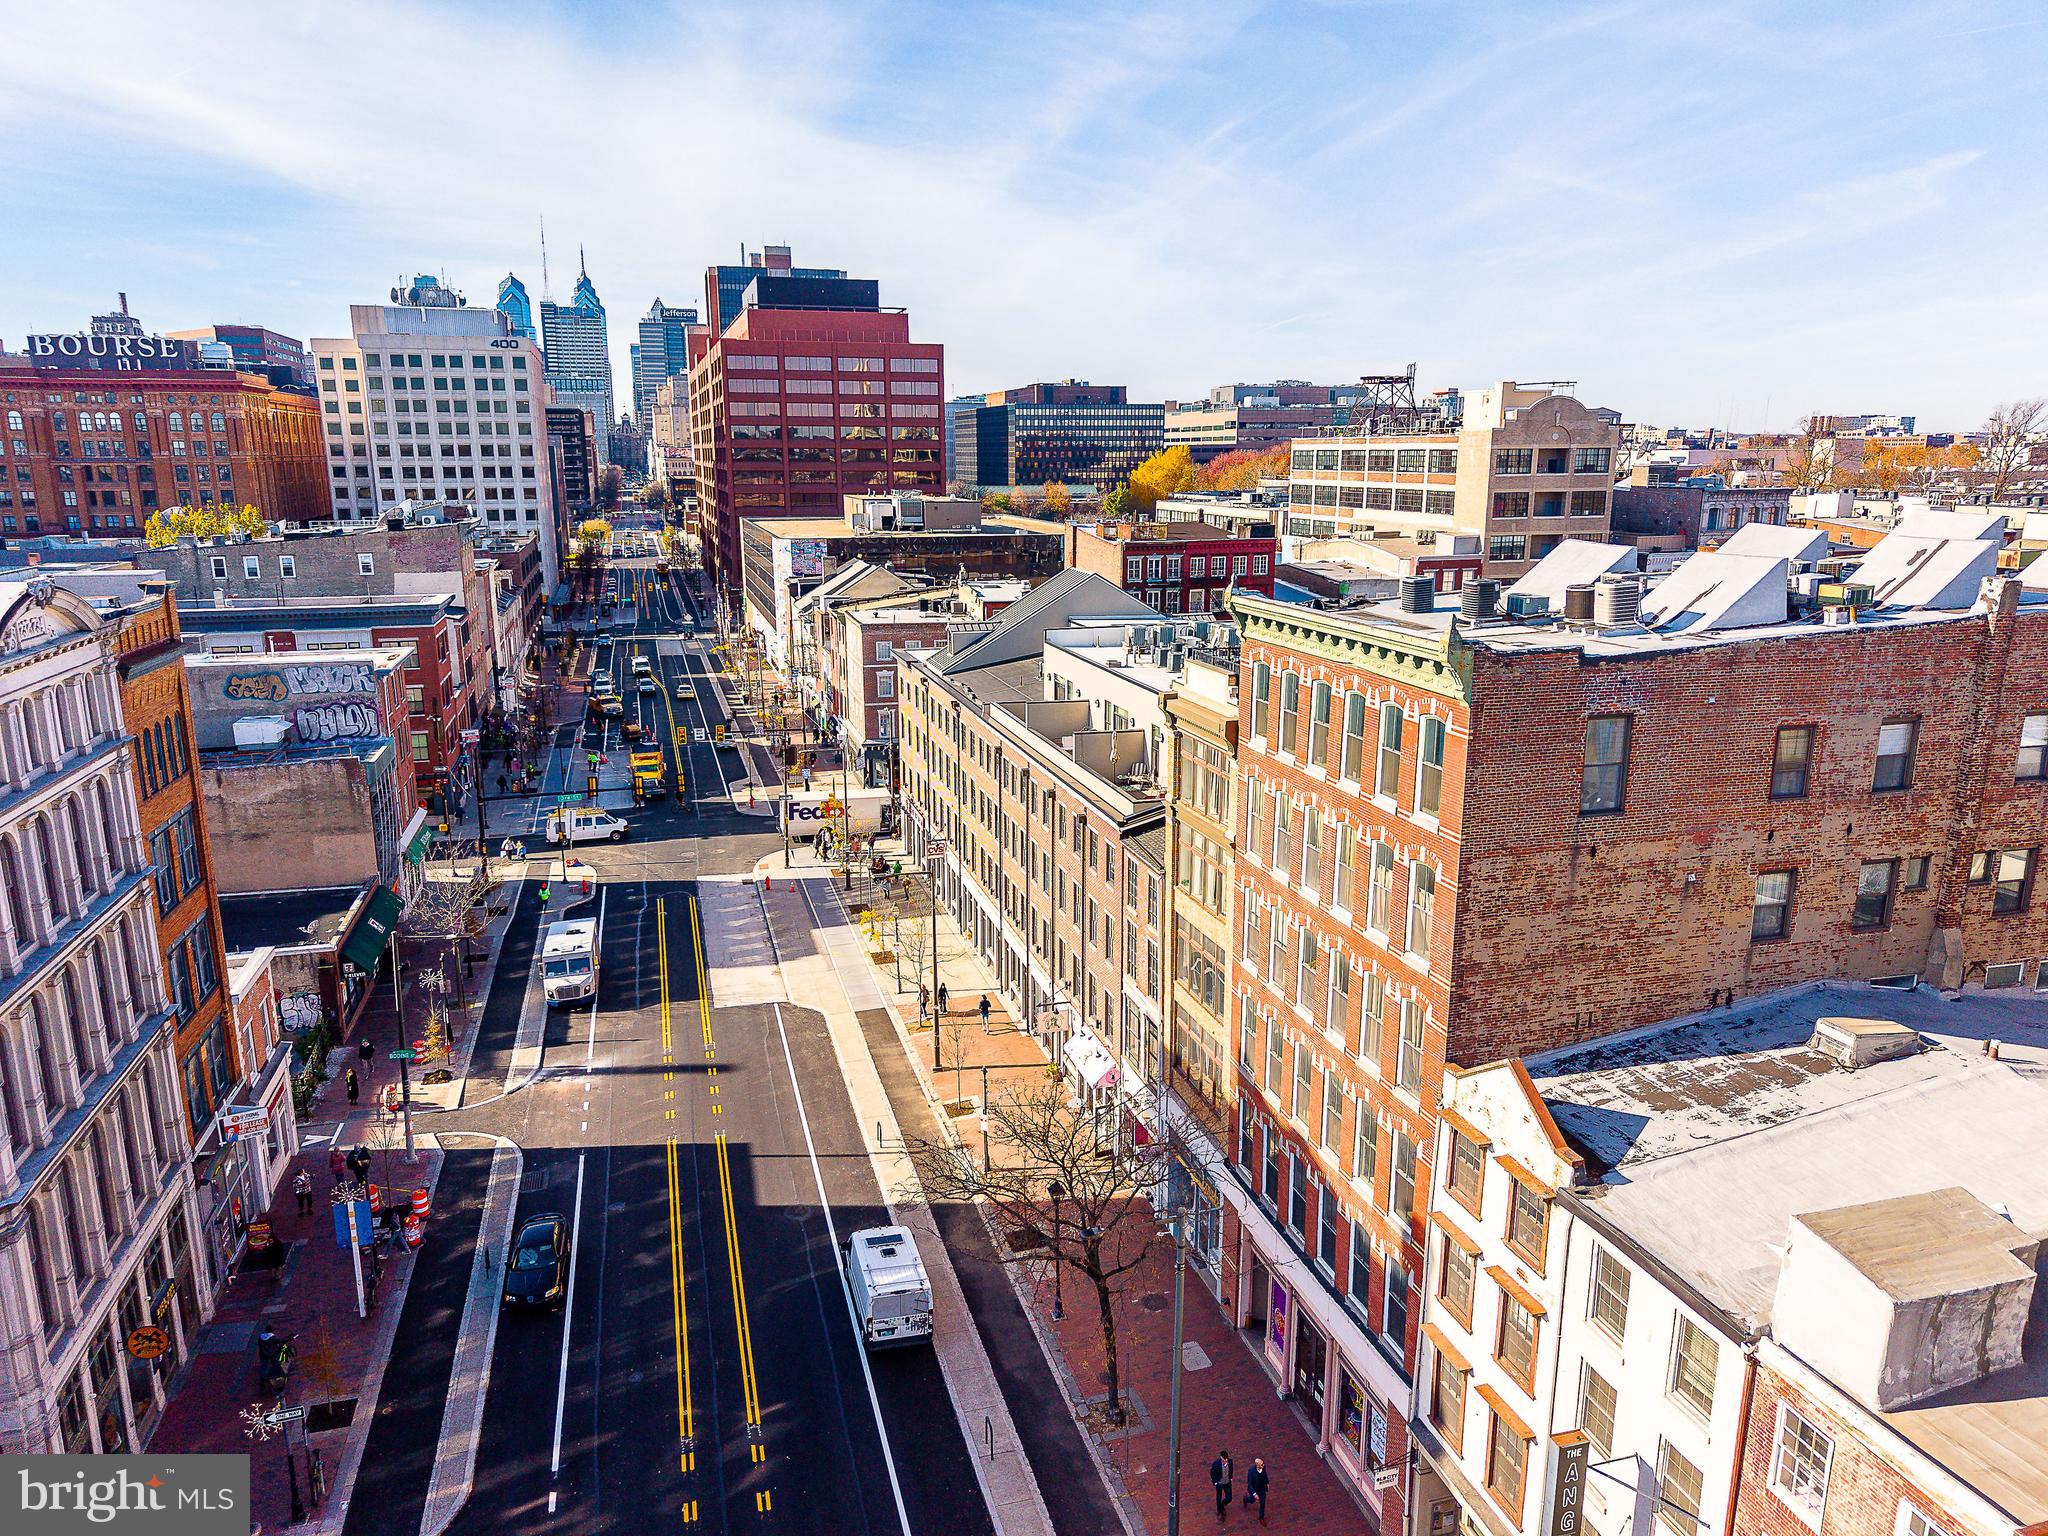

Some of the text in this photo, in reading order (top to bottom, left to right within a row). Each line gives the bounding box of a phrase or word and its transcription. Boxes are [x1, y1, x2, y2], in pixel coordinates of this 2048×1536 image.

[662, 309, 697, 318] Jefferson
[92, 323, 126, 333] THE
[33, 335, 178, 358] BOURSE
[490, 339, 519, 349] 400
[928, 846, 944, 854] CVS
[249, 1118, 266, 1128] LEASE
[276, 1409, 300, 1420] ONE WAY
[1566, 1447, 1583, 1459] THE
[1387, 1472, 1398, 1480] CITY
[1560, 1462, 1579, 1536] ANG
